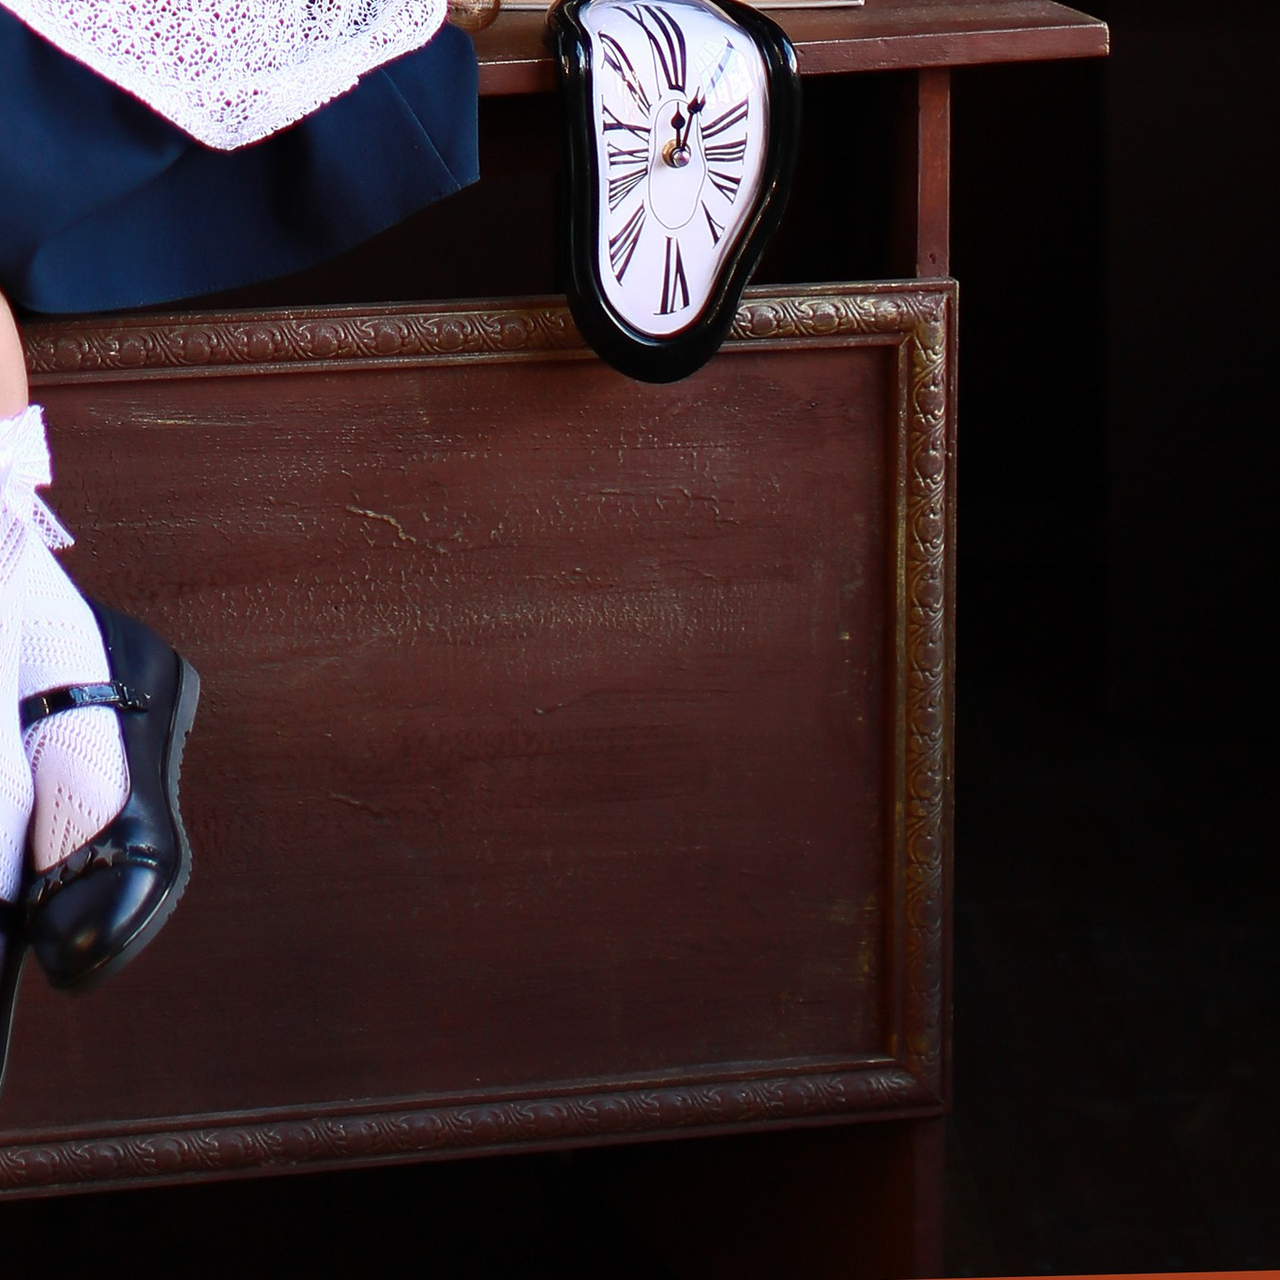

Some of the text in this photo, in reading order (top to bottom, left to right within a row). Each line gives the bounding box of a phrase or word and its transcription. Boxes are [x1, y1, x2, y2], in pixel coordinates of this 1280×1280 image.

[608, 3, 688, 102] XII
[699, 94, 749, 142] II
[705, 132, 748, 166] III
